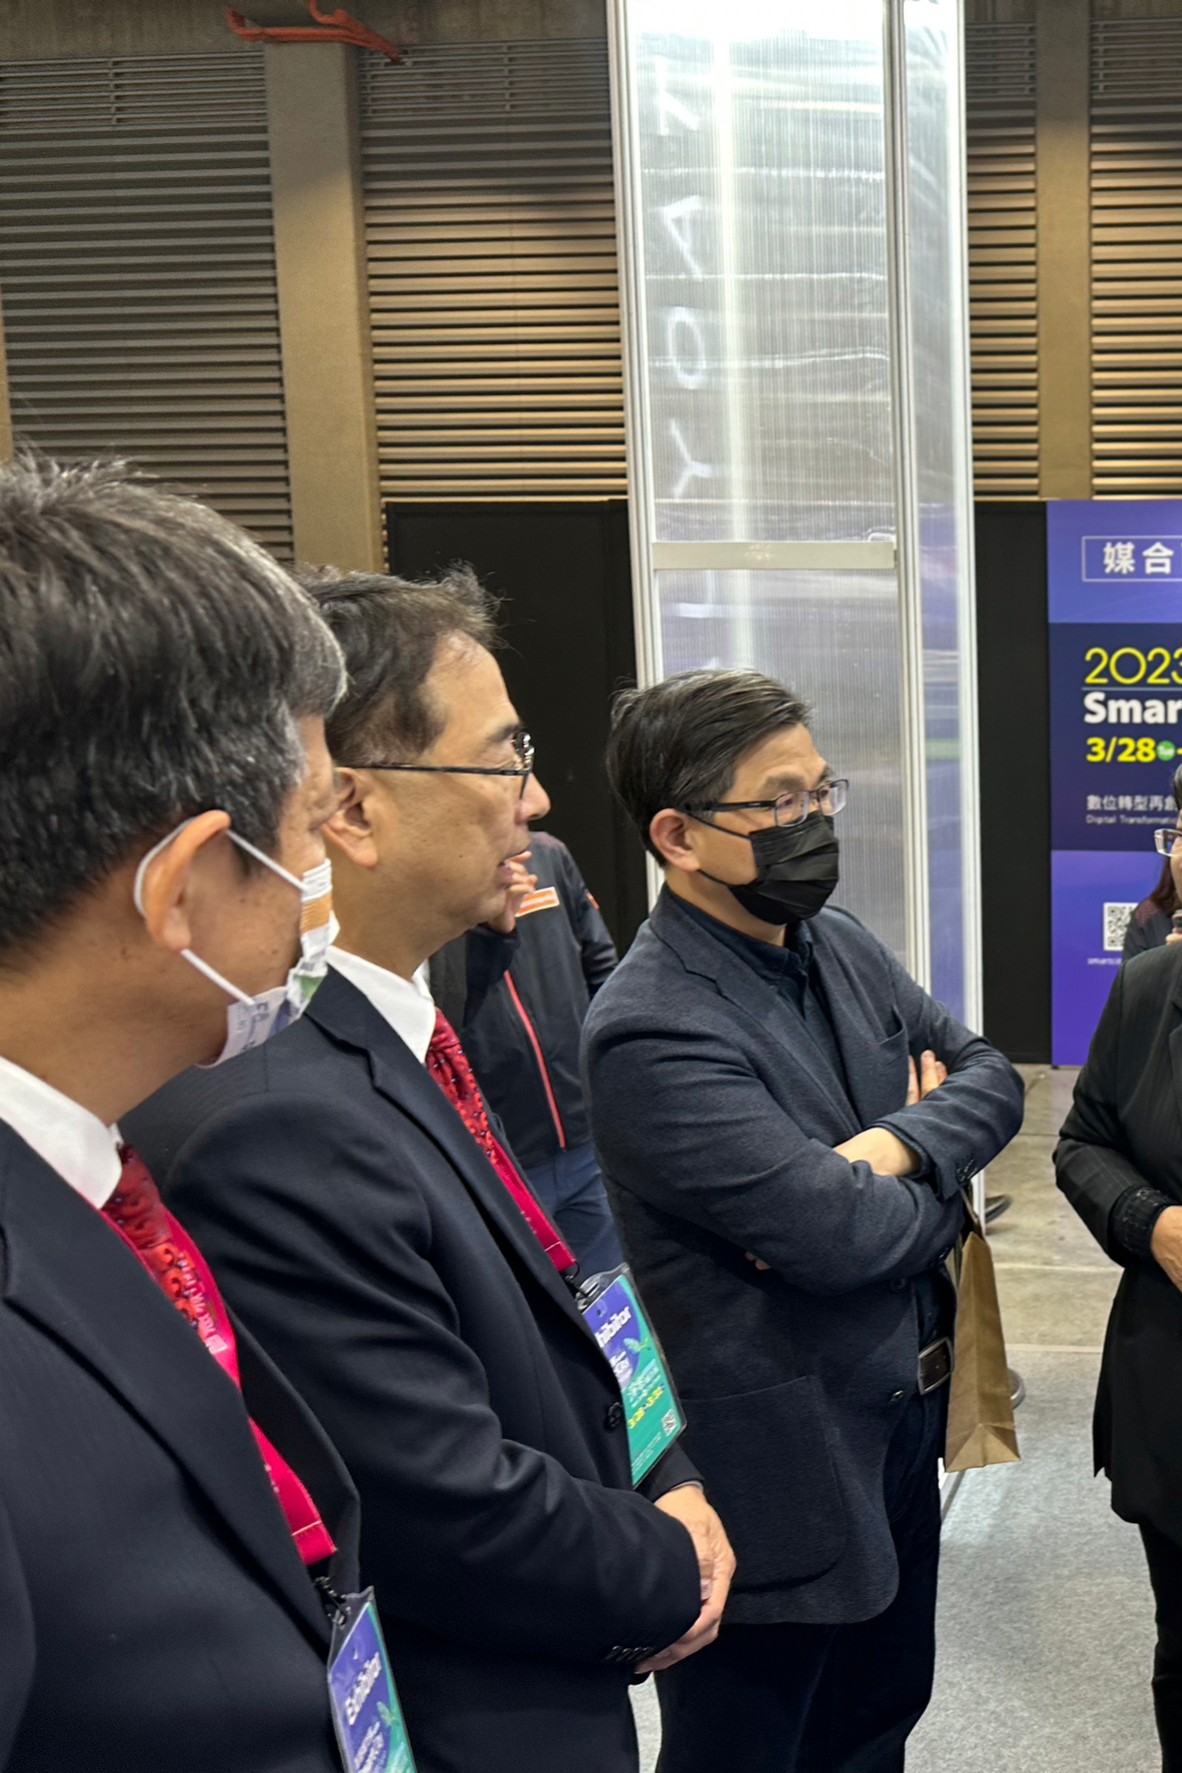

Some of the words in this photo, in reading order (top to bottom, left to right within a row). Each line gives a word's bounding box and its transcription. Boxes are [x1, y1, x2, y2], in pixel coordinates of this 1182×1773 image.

[1086, 737, 1156, 763] 3/28
[1086, 814, 1116, 825] Digital
[595, 1306, 631, 1348] hibitor
